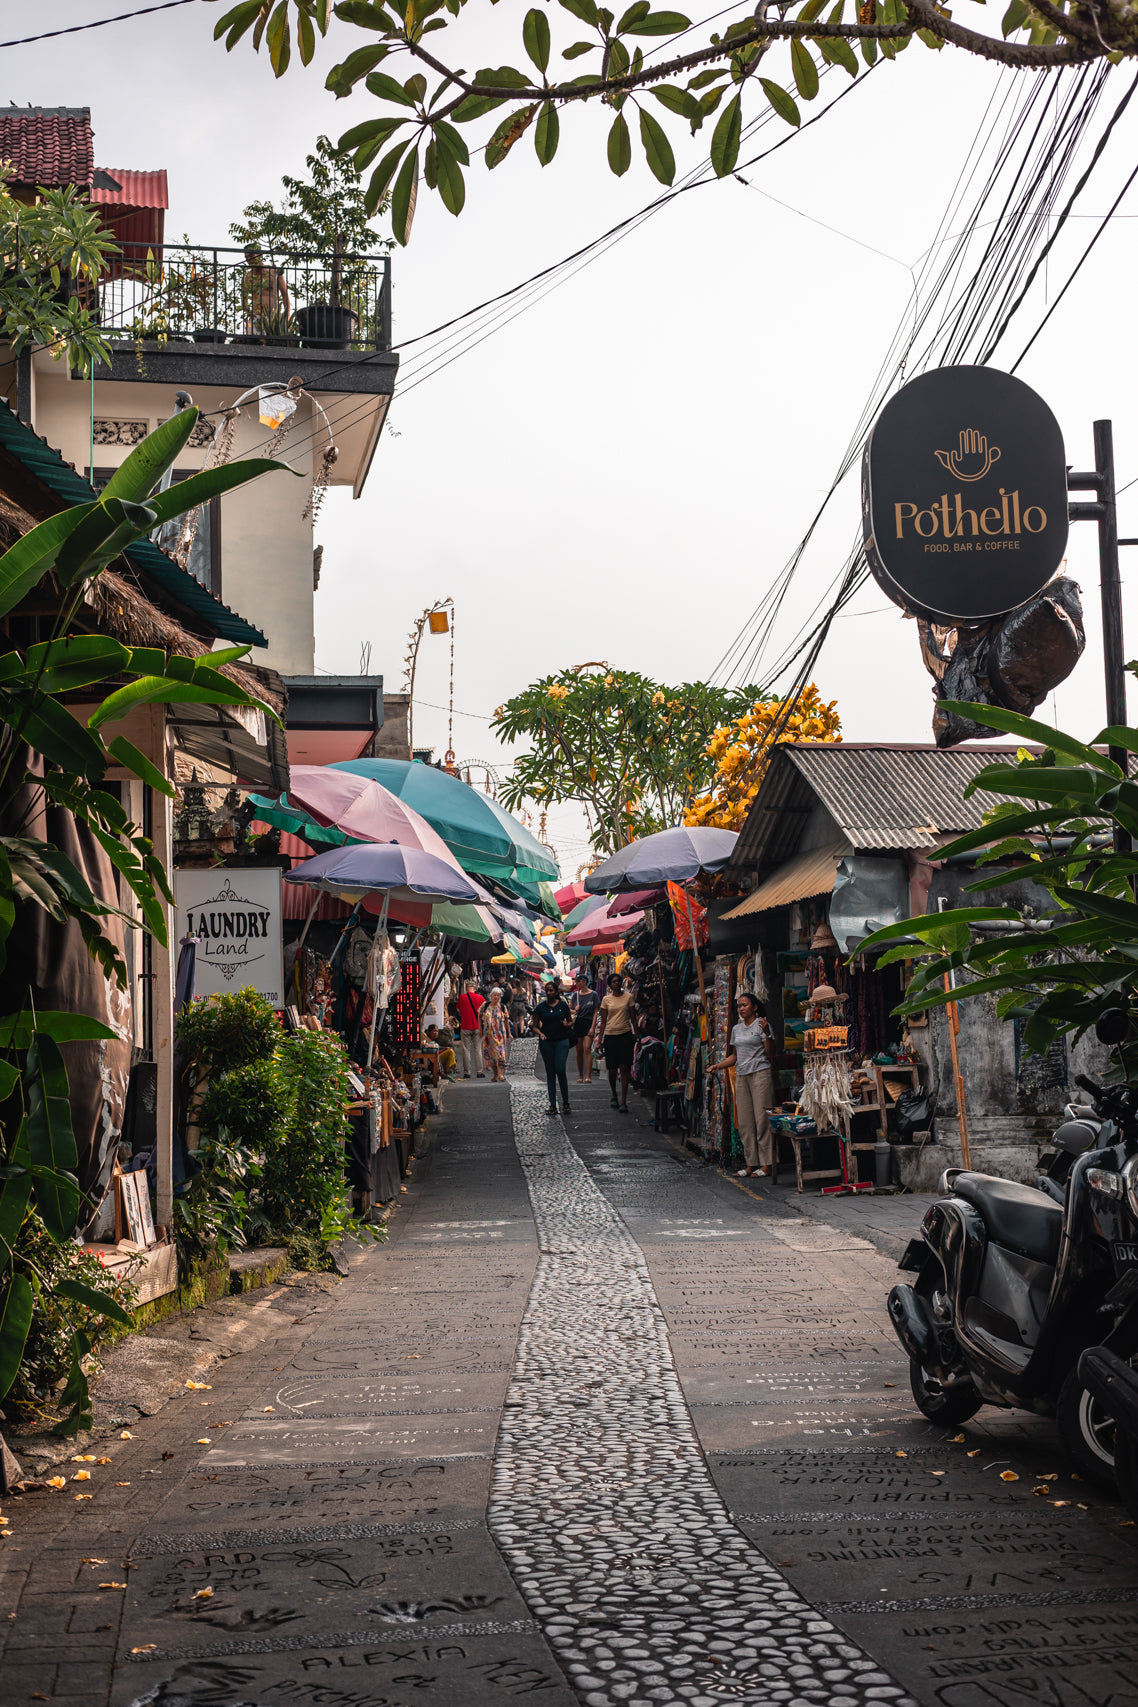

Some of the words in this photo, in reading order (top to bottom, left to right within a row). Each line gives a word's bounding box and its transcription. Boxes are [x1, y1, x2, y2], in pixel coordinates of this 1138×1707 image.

[894, 488, 1047, 538] Pothello
[924, 544, 951, 553] FOOD,
[954, 543, 973, 552] BAR
[976, 542, 982, 551] &
[985, 540, 1021, 551] COFFEE
[186, 912, 271, 939] LAUNDRY
[205, 938, 249, 955] Land
[304, 1465, 446, 1481] LUCA
[382, 1546, 460, 1558] 2012
